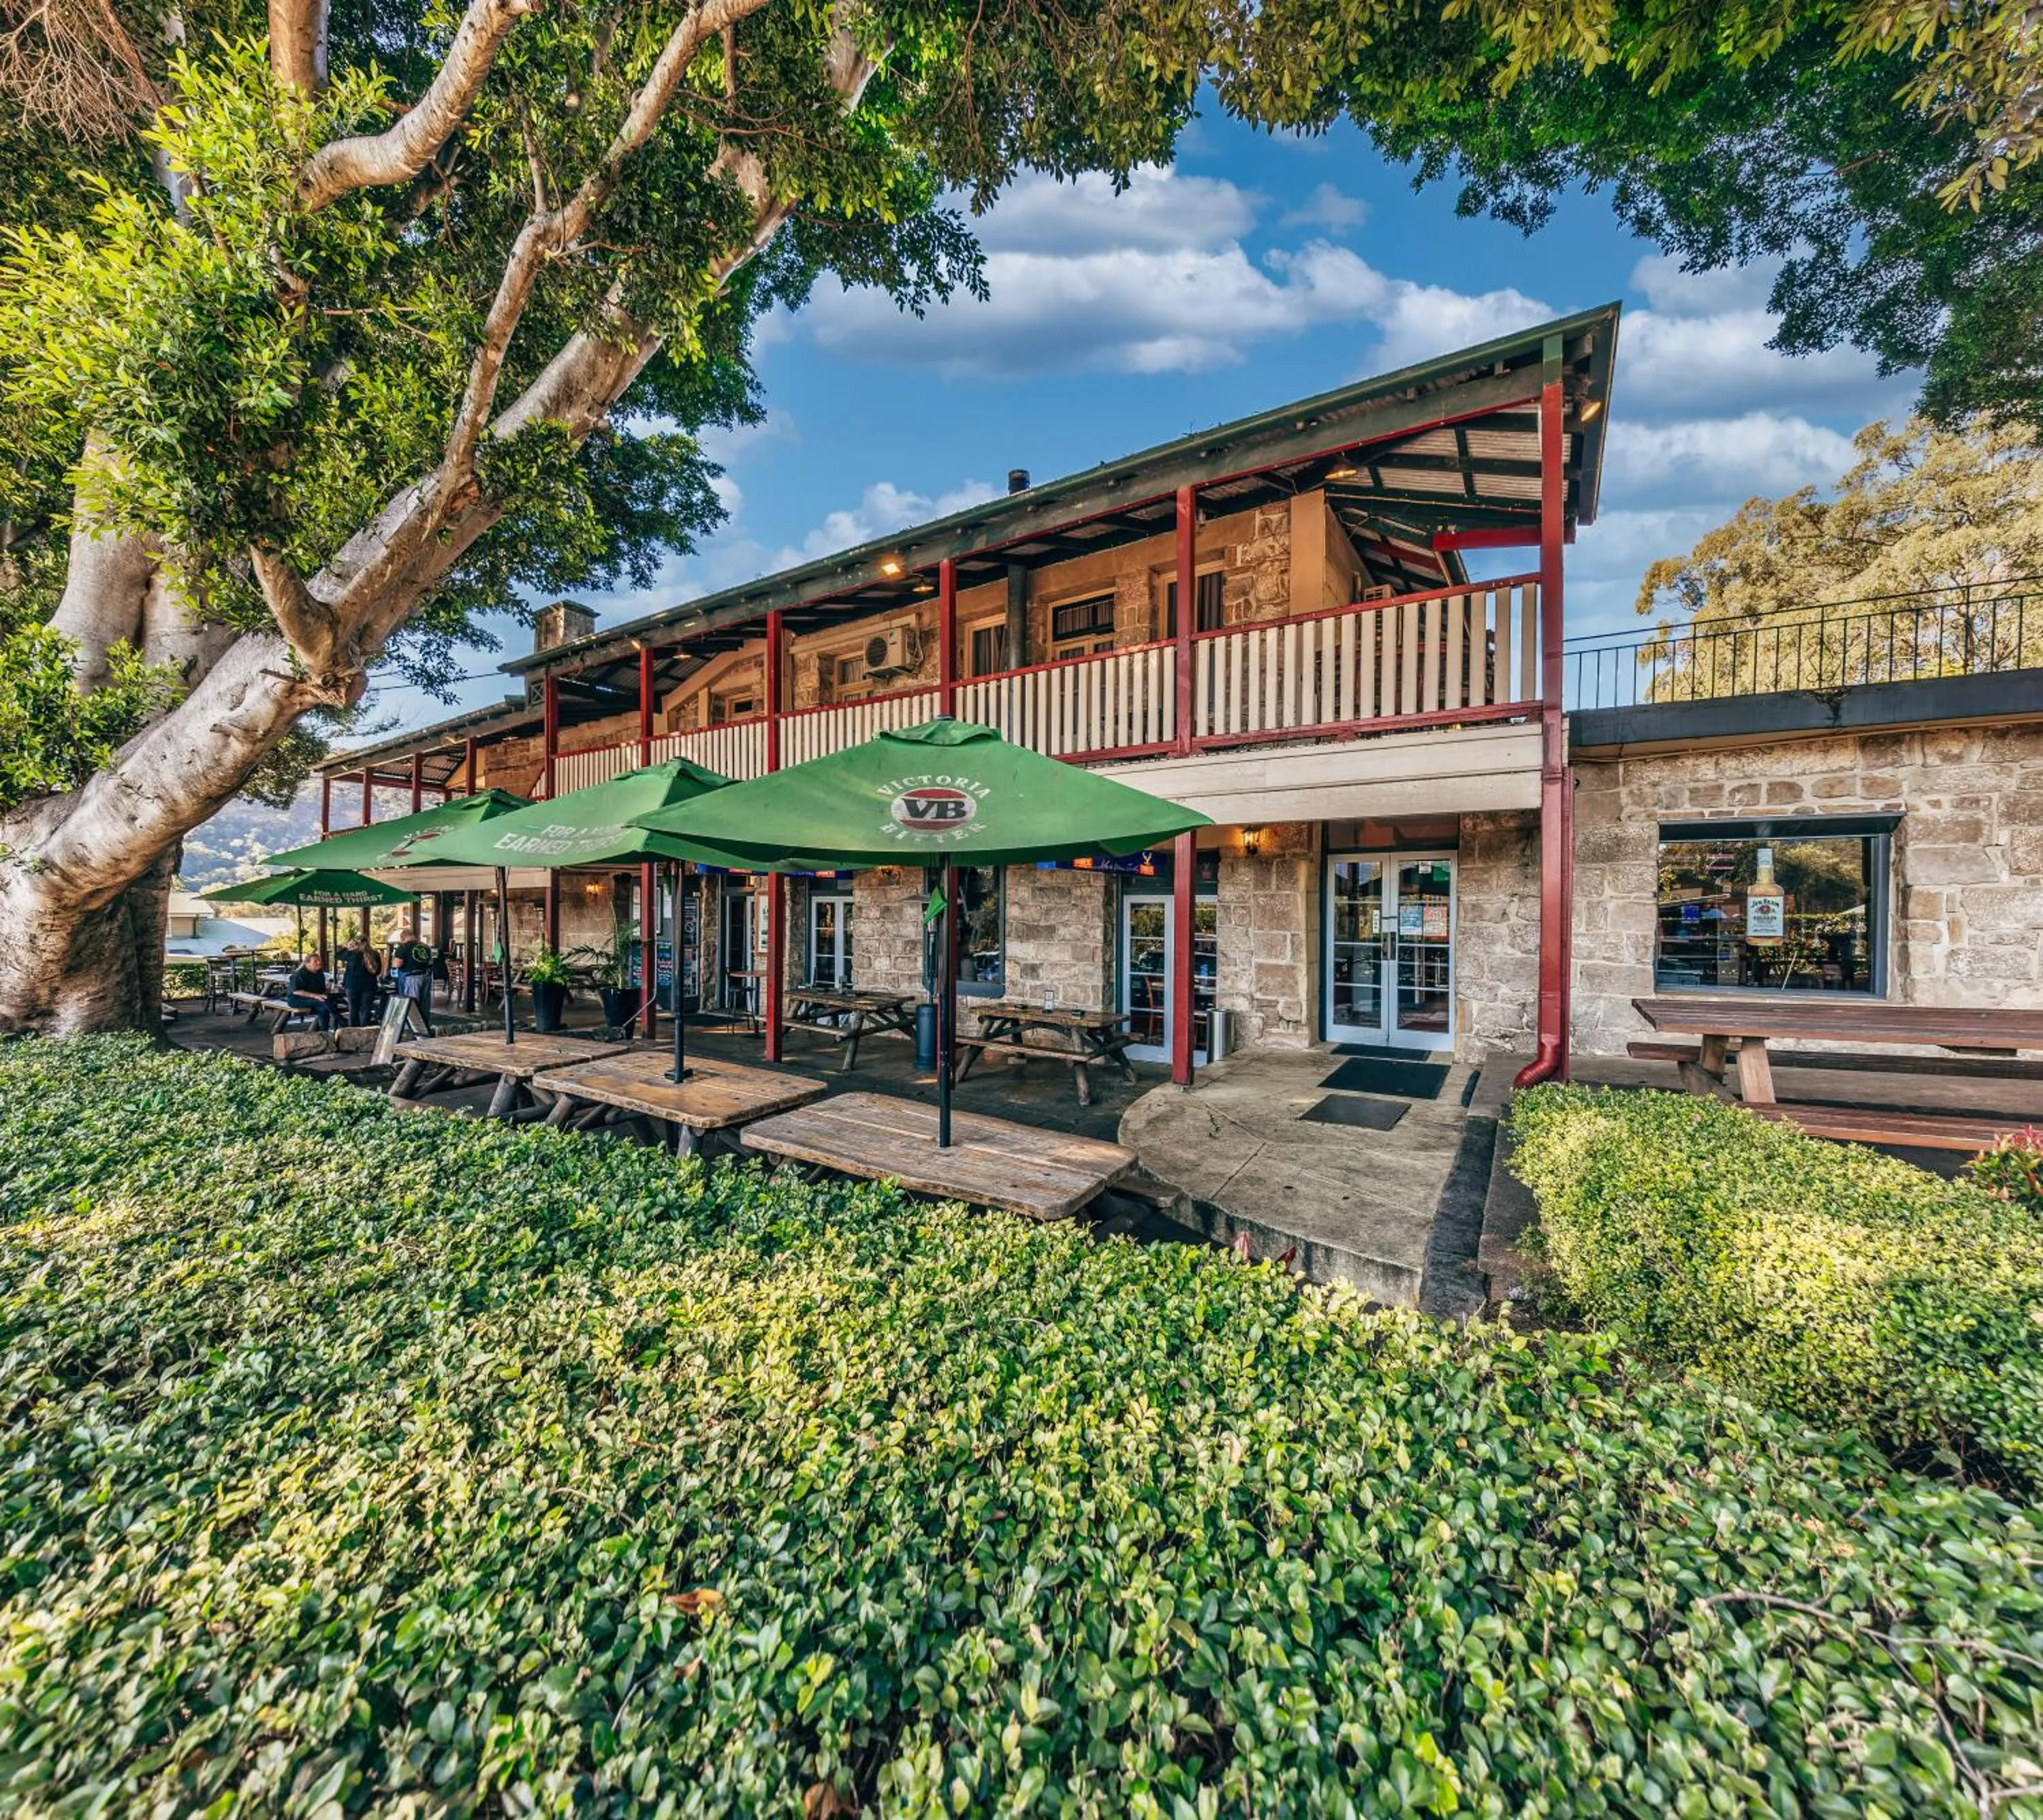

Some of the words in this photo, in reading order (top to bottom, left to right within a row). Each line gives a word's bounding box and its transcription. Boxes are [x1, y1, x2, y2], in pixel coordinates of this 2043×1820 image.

[875, 774, 992, 799] VICTORIA
[900, 798, 967, 819] VB
[493, 832, 573, 855] EARNED
[299, 892, 343, 904] EARNED
[345, 893, 383, 904] THIRST
[313, 889, 330, 897] FOR
[342, 890, 368, 898] HARD
